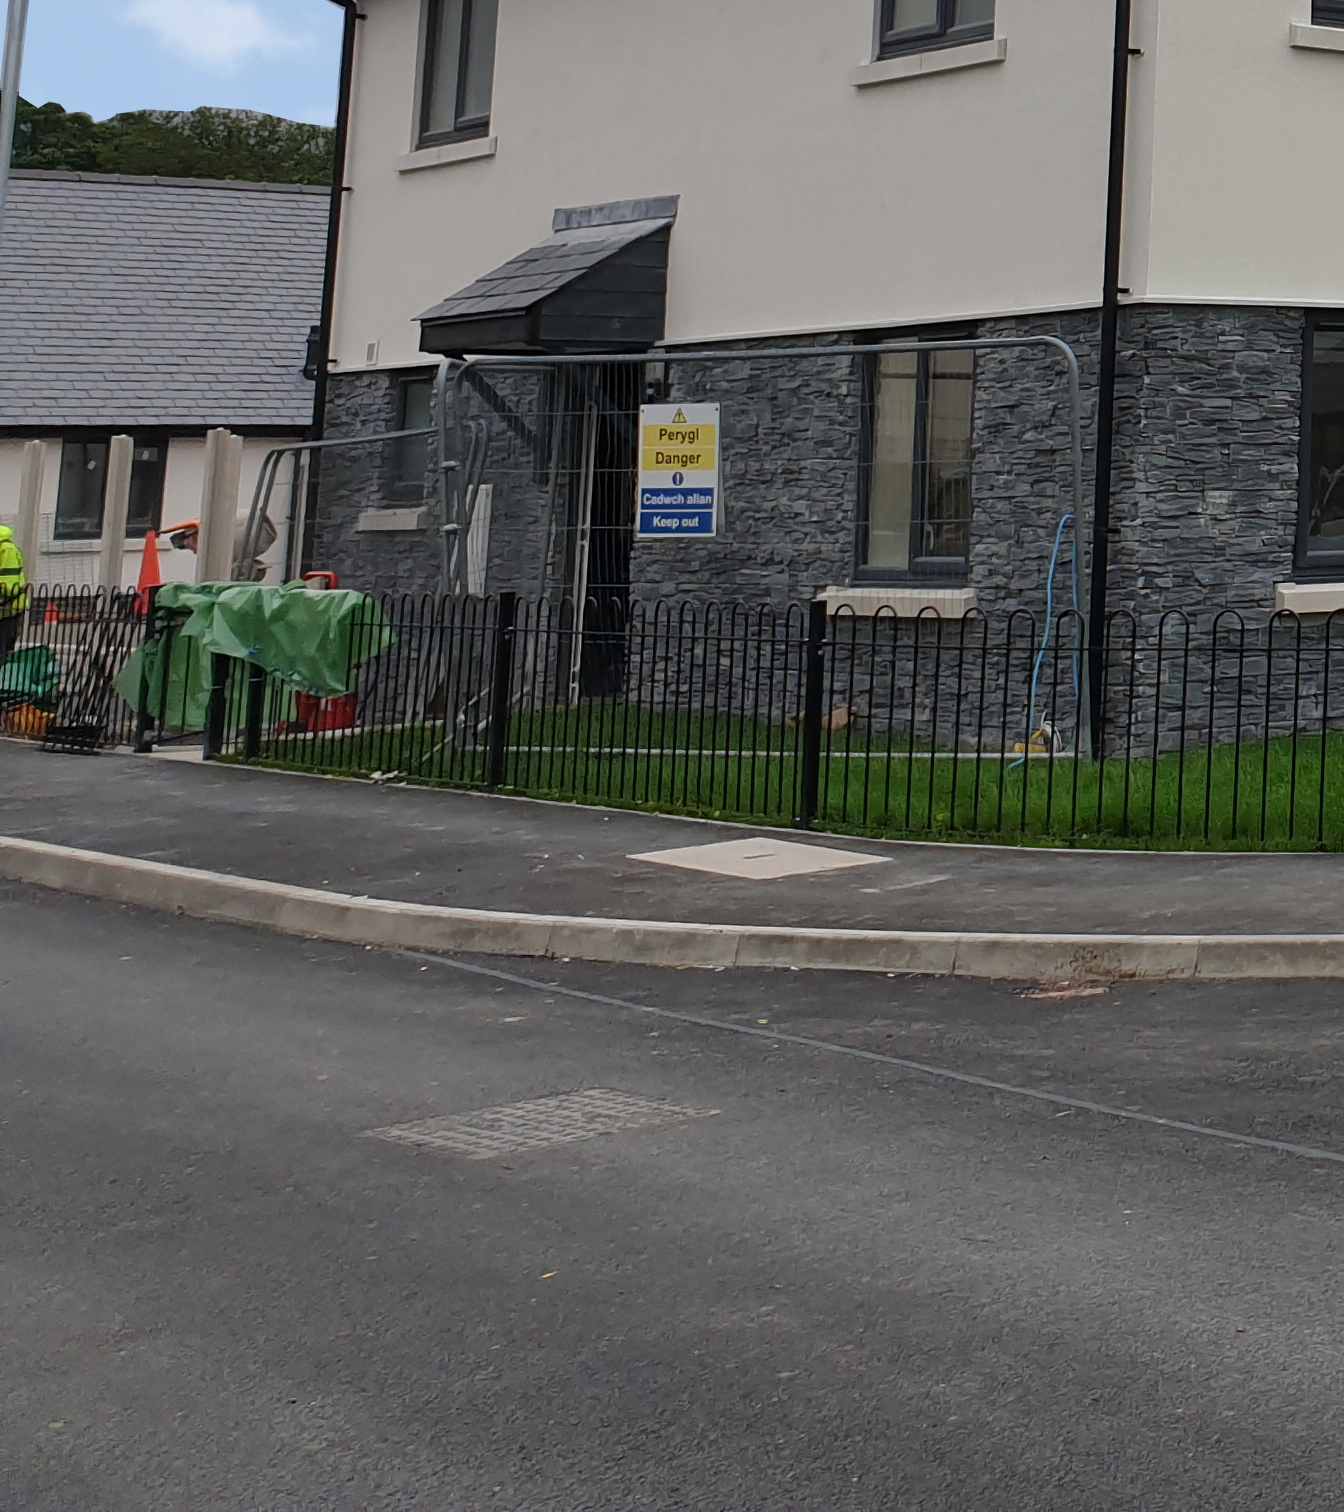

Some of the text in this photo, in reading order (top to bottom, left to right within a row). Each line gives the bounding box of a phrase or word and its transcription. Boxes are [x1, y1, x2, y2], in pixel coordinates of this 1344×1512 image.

[659, 428, 699, 444] Perygl
[655, 451, 702, 467] Danger
[643, 493, 712, 505] Cadwch allan
[653, 515, 699, 530] Keep out
